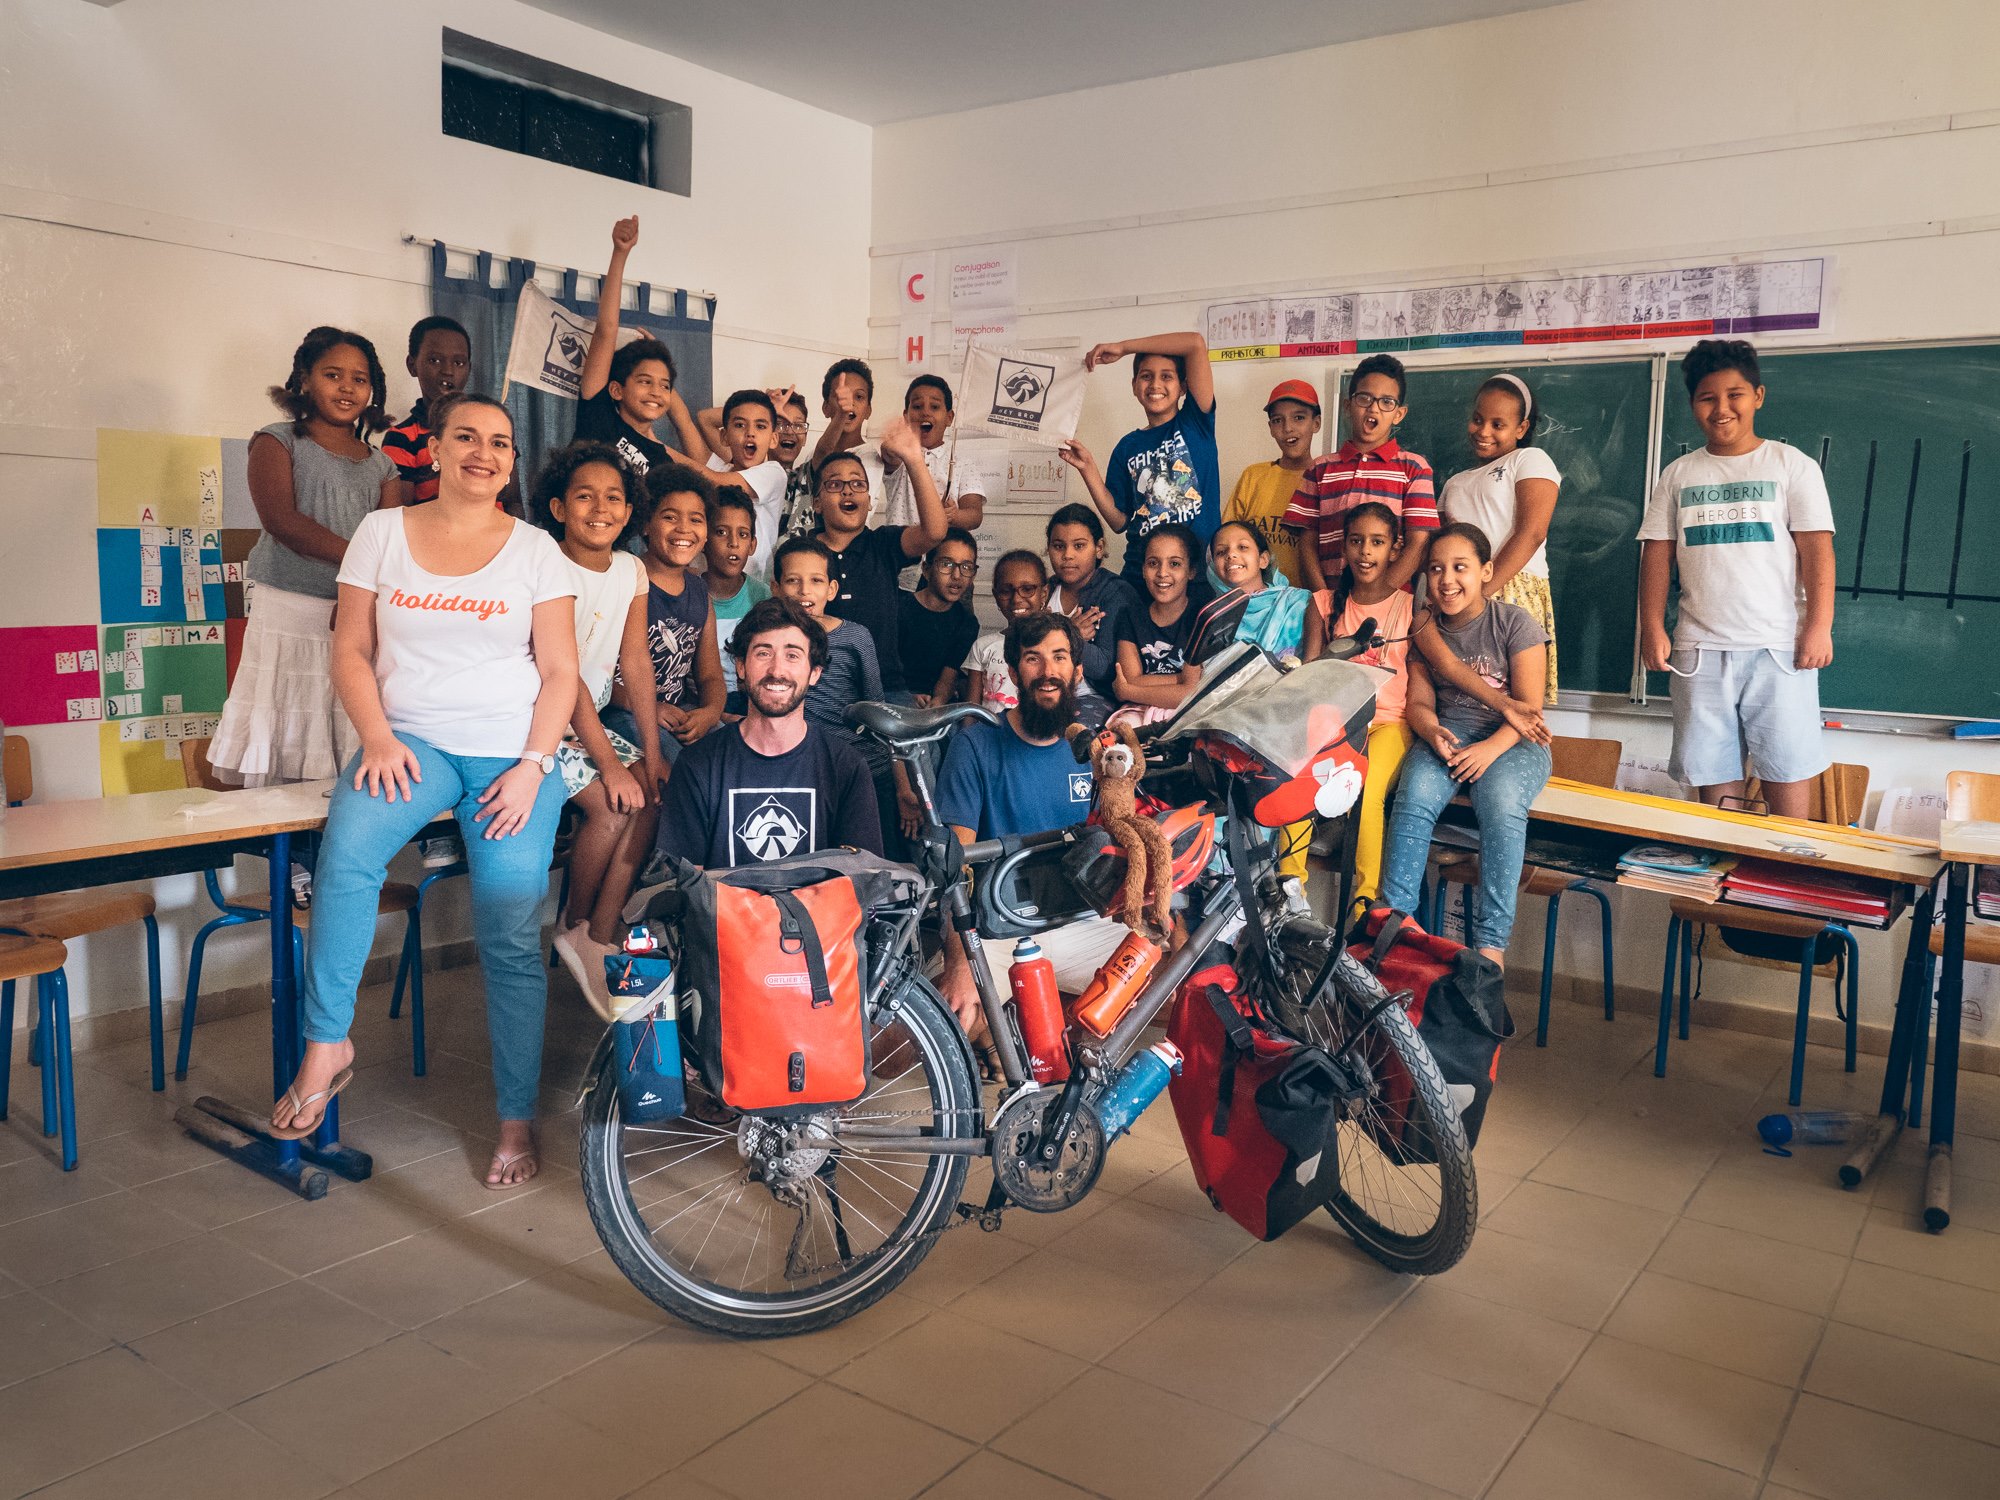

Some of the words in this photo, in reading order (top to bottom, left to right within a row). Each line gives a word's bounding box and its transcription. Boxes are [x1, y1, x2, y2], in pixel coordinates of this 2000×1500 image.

[908, 274, 925, 301] C
[907, 336, 923, 362] H
[1692, 486, 1763, 503] MODERN
[1697, 507, 1757, 522] HEROES
[1700, 526, 1755, 541] UNITED
[389, 588, 510, 621] holidays
[768, 976, 798, 984] ORTLIEB
